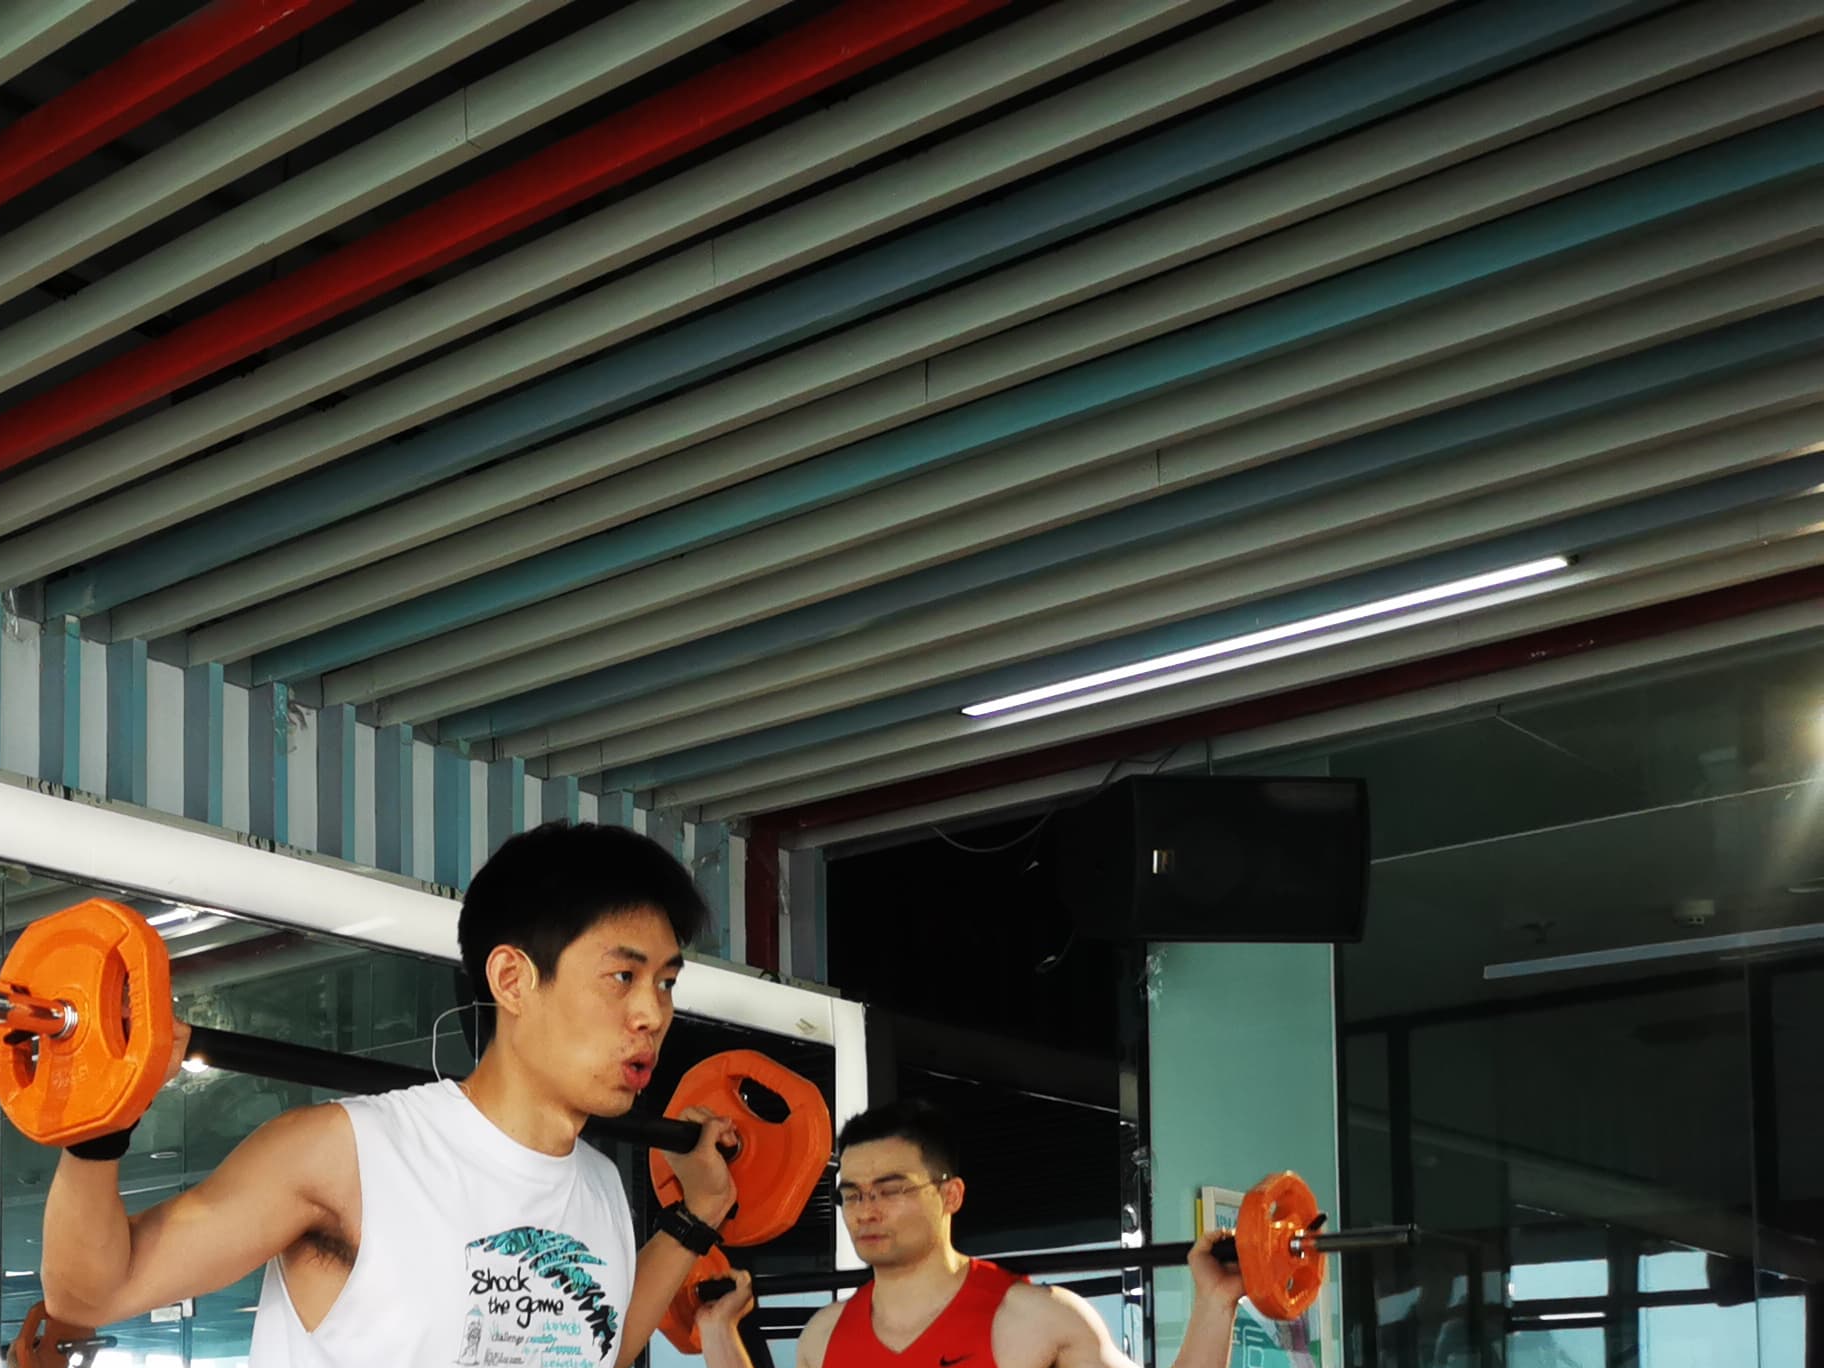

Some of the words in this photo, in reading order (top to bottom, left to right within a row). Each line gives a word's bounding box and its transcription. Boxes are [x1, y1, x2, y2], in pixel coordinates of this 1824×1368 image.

[468, 1266, 532, 1295] Shock
[487, 1297, 511, 1316] the
[516, 1295, 565, 1329] game
